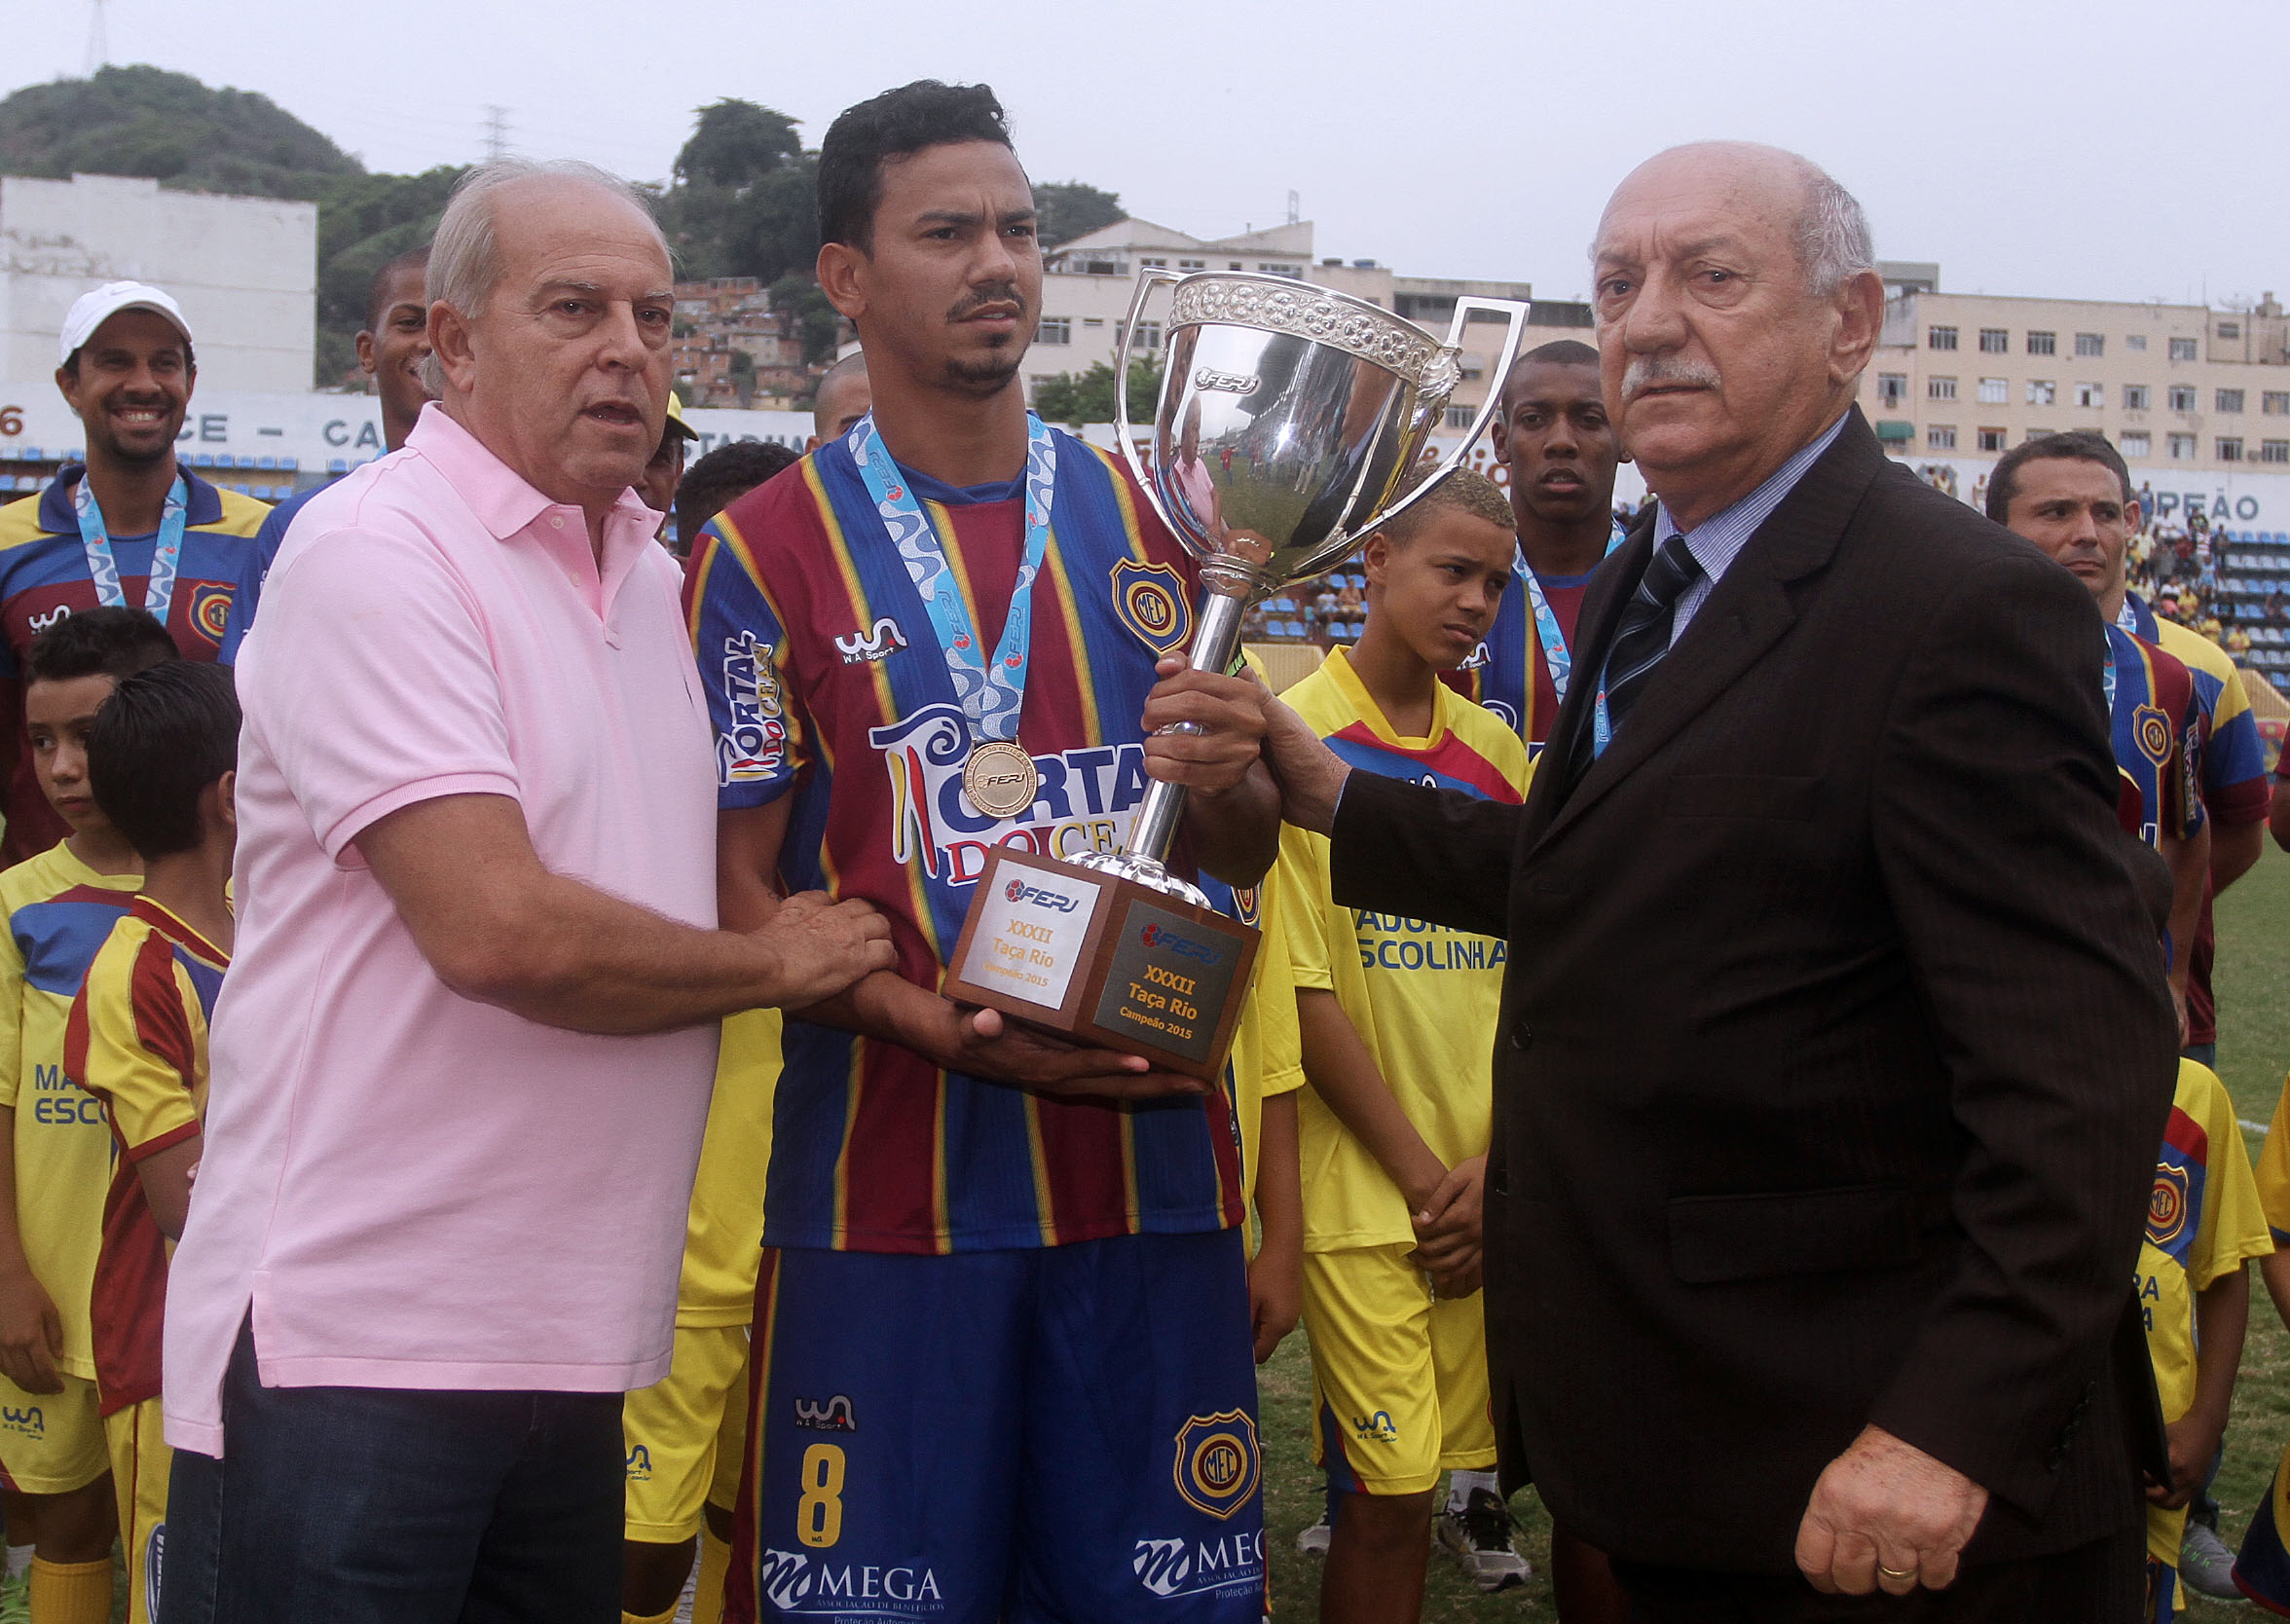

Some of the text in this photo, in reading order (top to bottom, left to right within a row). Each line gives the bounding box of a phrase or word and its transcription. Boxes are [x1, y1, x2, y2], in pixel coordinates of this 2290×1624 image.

[1205, 374, 1257, 390] FERJ
[322, 420, 380, 449] CA
[866, 646, 895, 660] Sport
[871, 706, 1145, 876] PORTA
[986, 773, 1025, 786] FERJ
[1018, 886, 1080, 912] FERJ
[1006, 919, 1053, 943] XXXII
[993, 937, 1054, 968] Taça Rio
[1155, 932, 1222, 965] FERJ
[1359, 940, 1507, 970] SCOLINHA
[1026, 974, 1050, 987] 2015
[1143, 964, 1197, 995] XXXII
[1129, 981, 1199, 1020] Taça Rio
[1120, 1007, 1193, 1040] Campeão 2015
[1204, 1448, 1237, 1483] MEC
[797, 1443, 846, 1548] 8
[817, 1563, 942, 1601] MEGA
